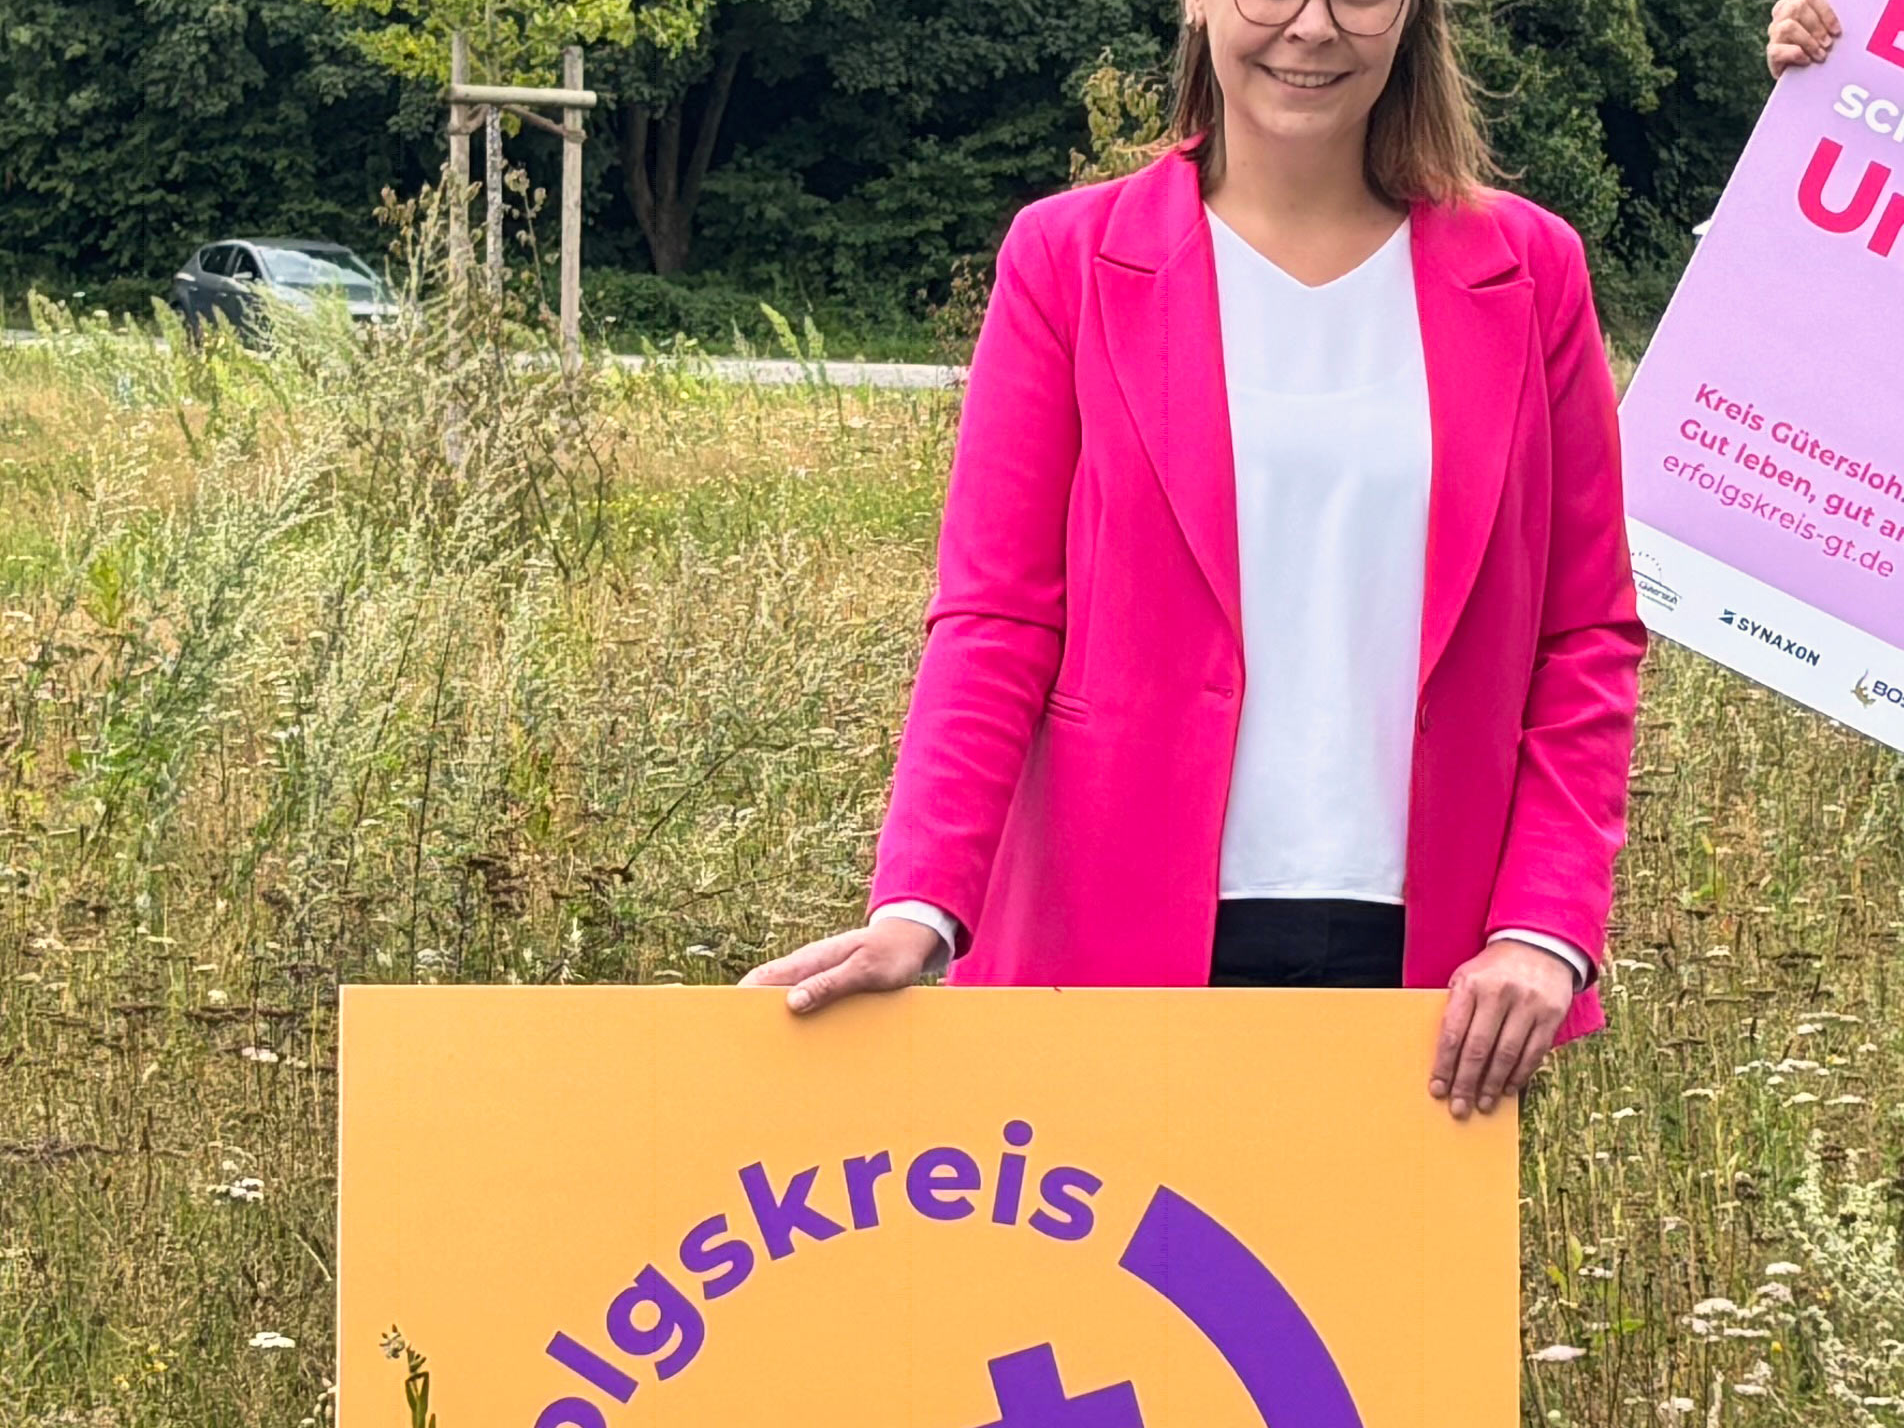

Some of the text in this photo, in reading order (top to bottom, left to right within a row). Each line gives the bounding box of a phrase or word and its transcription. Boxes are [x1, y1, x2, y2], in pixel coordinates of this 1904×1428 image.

[1695, 382, 1765, 432] Kreis
[1679, 418, 1730, 457] Gut
[1733, 443, 1817, 504] leben,
[1824, 493, 1876, 529] gut
[1662, 453, 1895, 579] erfolgskreis-gt.de
[1737, 617, 1822, 668] SYNAXON
